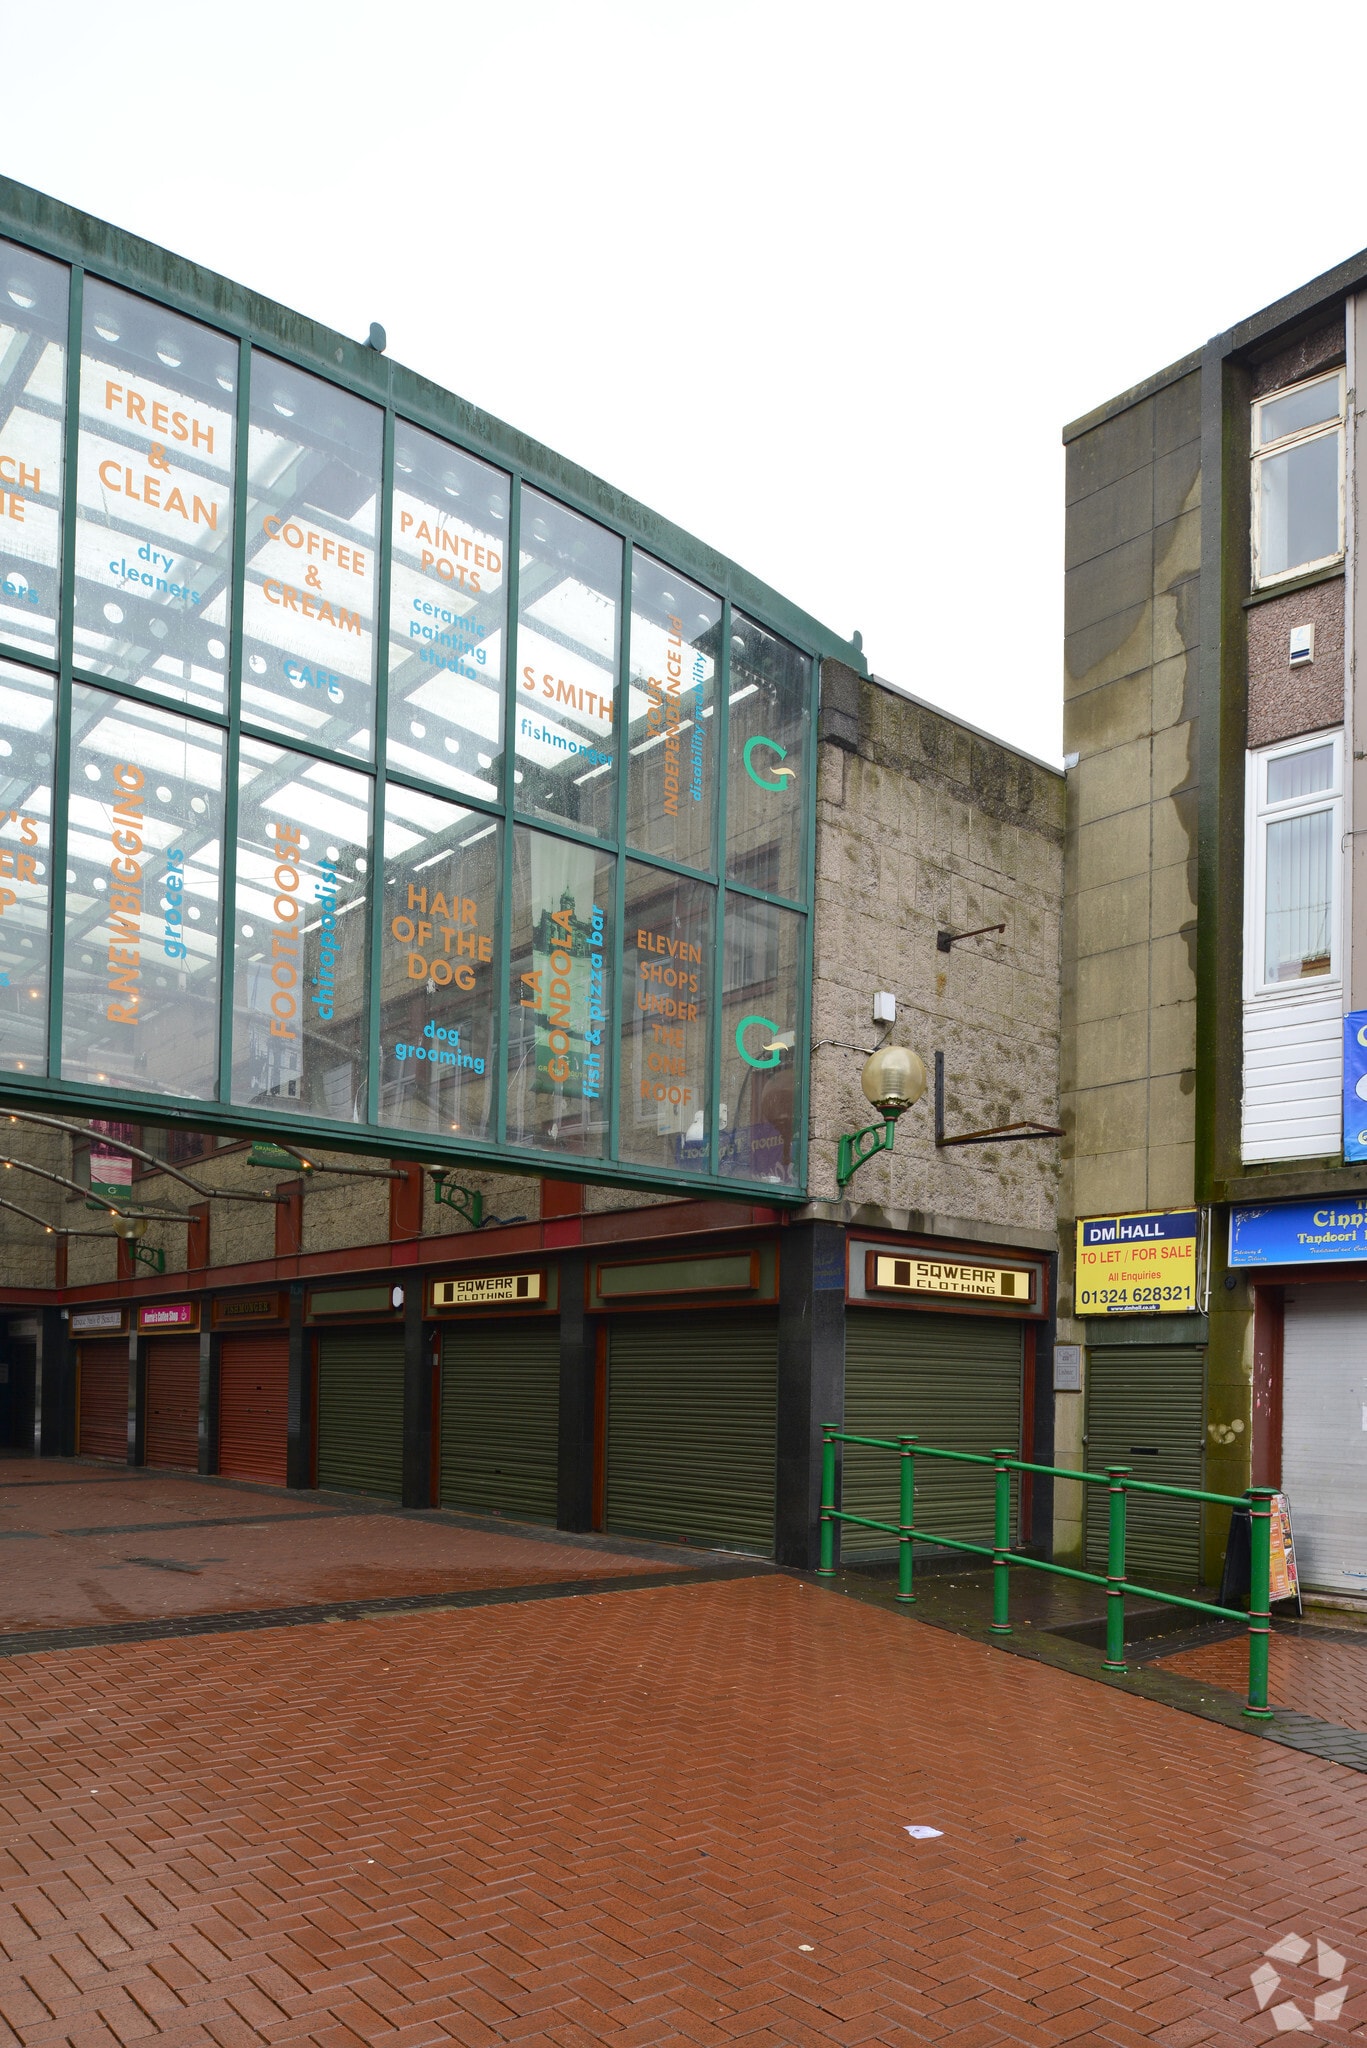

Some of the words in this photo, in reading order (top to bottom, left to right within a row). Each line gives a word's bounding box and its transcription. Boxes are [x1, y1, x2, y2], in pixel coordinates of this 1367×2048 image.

[105, 380, 215, 454] FRESH
[147, 442, 172, 475] &
[99, 460, 217, 531] CLEAN
[137, 543, 174, 573] dry
[263, 515, 365, 577] COFFEE
[400, 511, 502, 574] PAINTED
[109, 558, 201, 604] cleaners
[304, 564, 323, 590] &
[421, 548, 481, 594] POTS
[263, 579, 363, 636] CREAM
[413, 597, 487, 638] ceramic
[409, 618, 487, 666] painting
[667, 615, 683, 648] Ltd
[283, 660, 340, 695] CAFE
[419, 646, 477, 682] studio
[522, 666, 536, 692] S
[542, 673, 614, 723] SMITH
[692, 652, 708, 720] mobility
[646, 676, 664, 739] YOUR
[520, 718, 614, 768] fishmonger
[663, 649, 683, 818] INDEPENDENCE
[688, 724, 709, 801] disability
[164, 847, 187, 960] grocers
[407, 883, 478, 927] HAIR
[270, 823, 302, 1040] FOOTLOOSE
[311, 859, 338, 1021] chiropodist
[391, 915, 433, 950] OF
[439, 926, 493, 963] THE
[585, 904, 605, 948] bar
[637, 929, 702, 965] ELEVEN
[408, 953, 477, 991] DOG
[520, 969, 543, 1010] LA
[584, 951, 605, 1023] pizza
[640, 961, 699, 993] SHOPS
[547, 908, 573, 1083] GONDOLA
[637, 991, 698, 1023] UNDER
[423, 1019, 460, 1047] dog
[584, 1028, 601, 1046] &
[652, 1023, 685, 1049] THE
[395, 1041, 486, 1075] grooming
[582, 1051, 601, 1099] fish
[647, 1053, 687, 1077] ONE
[640, 1079, 692, 1107] ROOF
[1090, 1227, 1116, 1242] DM
[1120, 1223, 1165, 1239] HALL
[1297, 1230, 1357, 1246] Tandoori
[916, 1263, 996, 1284] SQWEAR
[1081, 1252, 1097, 1265] TO
[1100, 1250, 1122, 1263] LET
[1124, 1250, 1129, 1263] /
[1132, 1247, 1157, 1261] FOR
[1161, 1245, 1192, 1259] SALE
[457, 1277, 513, 1293] SQWEAR
[916, 1279, 996, 1295] CLOTHING
[1081, 1289, 1128, 1304] 01324
[1133, 1285, 1191, 1302] 628321
[1108, 1273, 1119, 1282] All
[1121, 1271, 1162, 1282] Enquiries
[223, 1301, 268, 1315] FISHMONGER
[457, 1291, 513, 1302] CLOTHING
